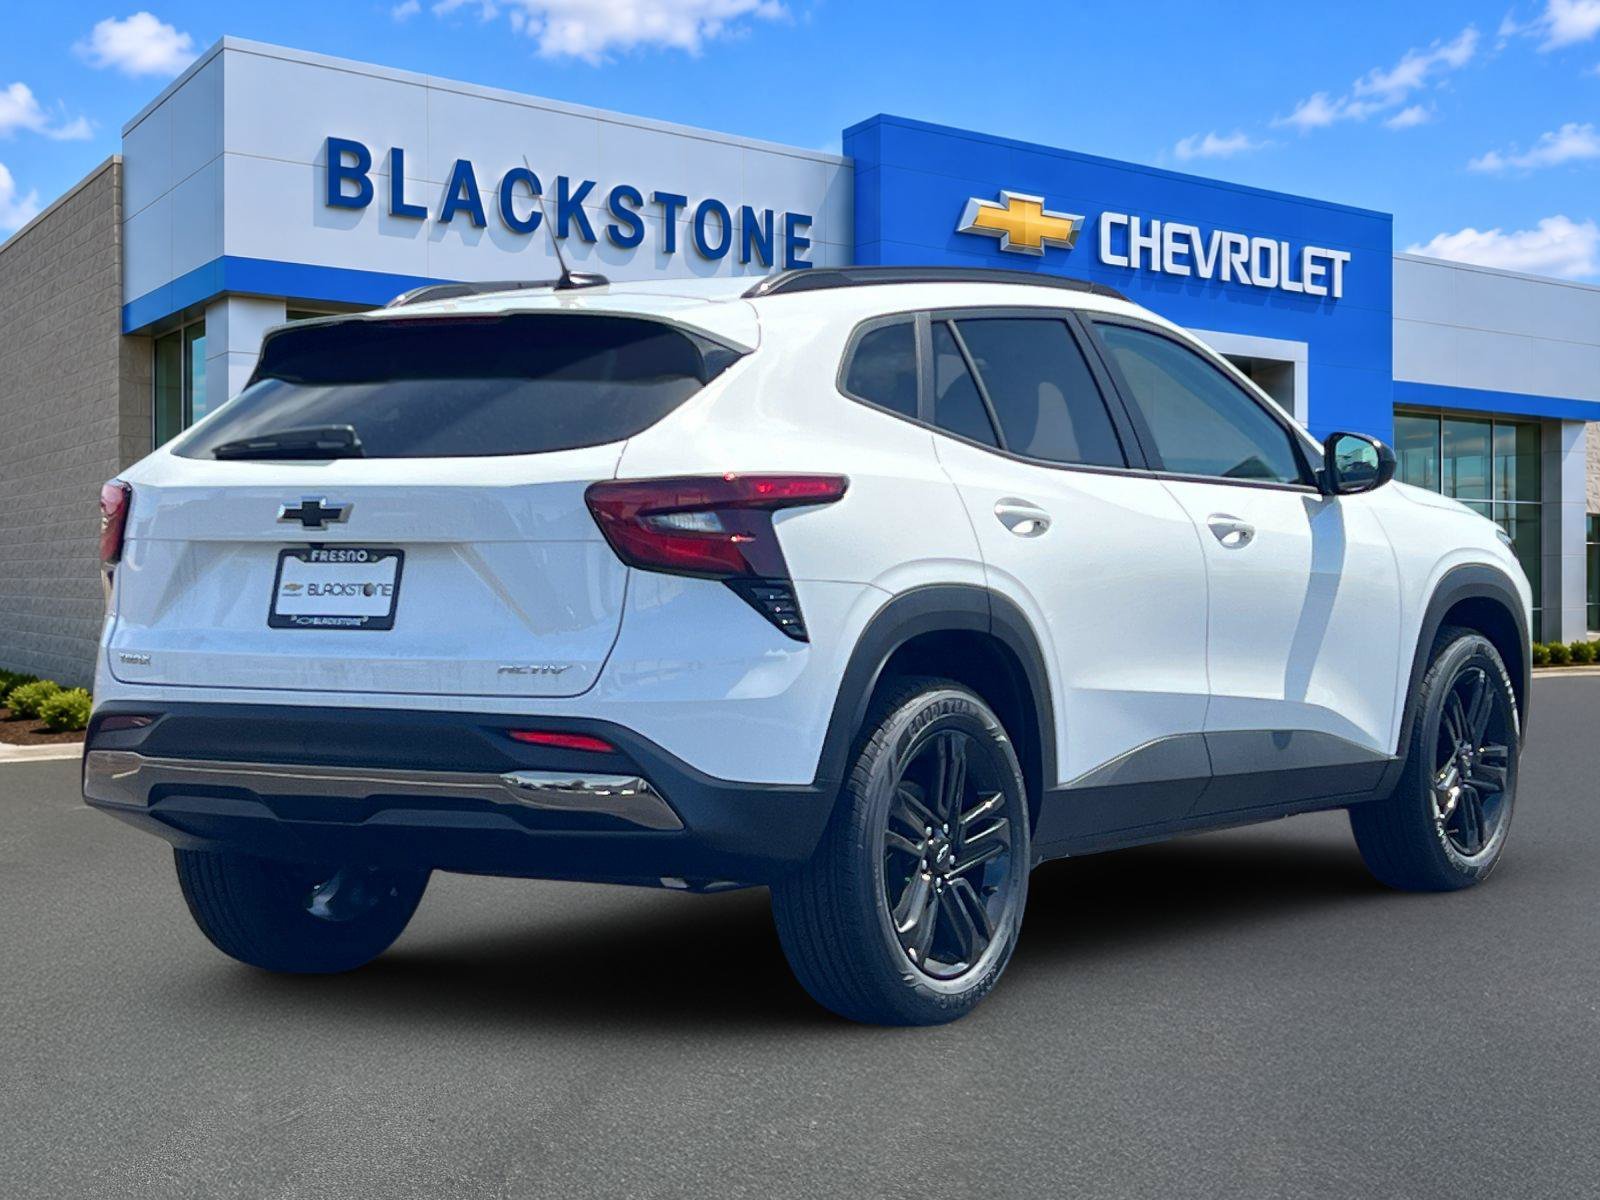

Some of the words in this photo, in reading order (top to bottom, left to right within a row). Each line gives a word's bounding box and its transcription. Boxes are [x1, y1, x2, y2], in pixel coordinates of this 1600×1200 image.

[325, 136, 814, 270] BLACKSTONE
[1100, 211, 1351, 299] CHEVROLET
[311, 550, 368, 562] FRESNO
[307, 583, 393, 597] BLACKSTONE
